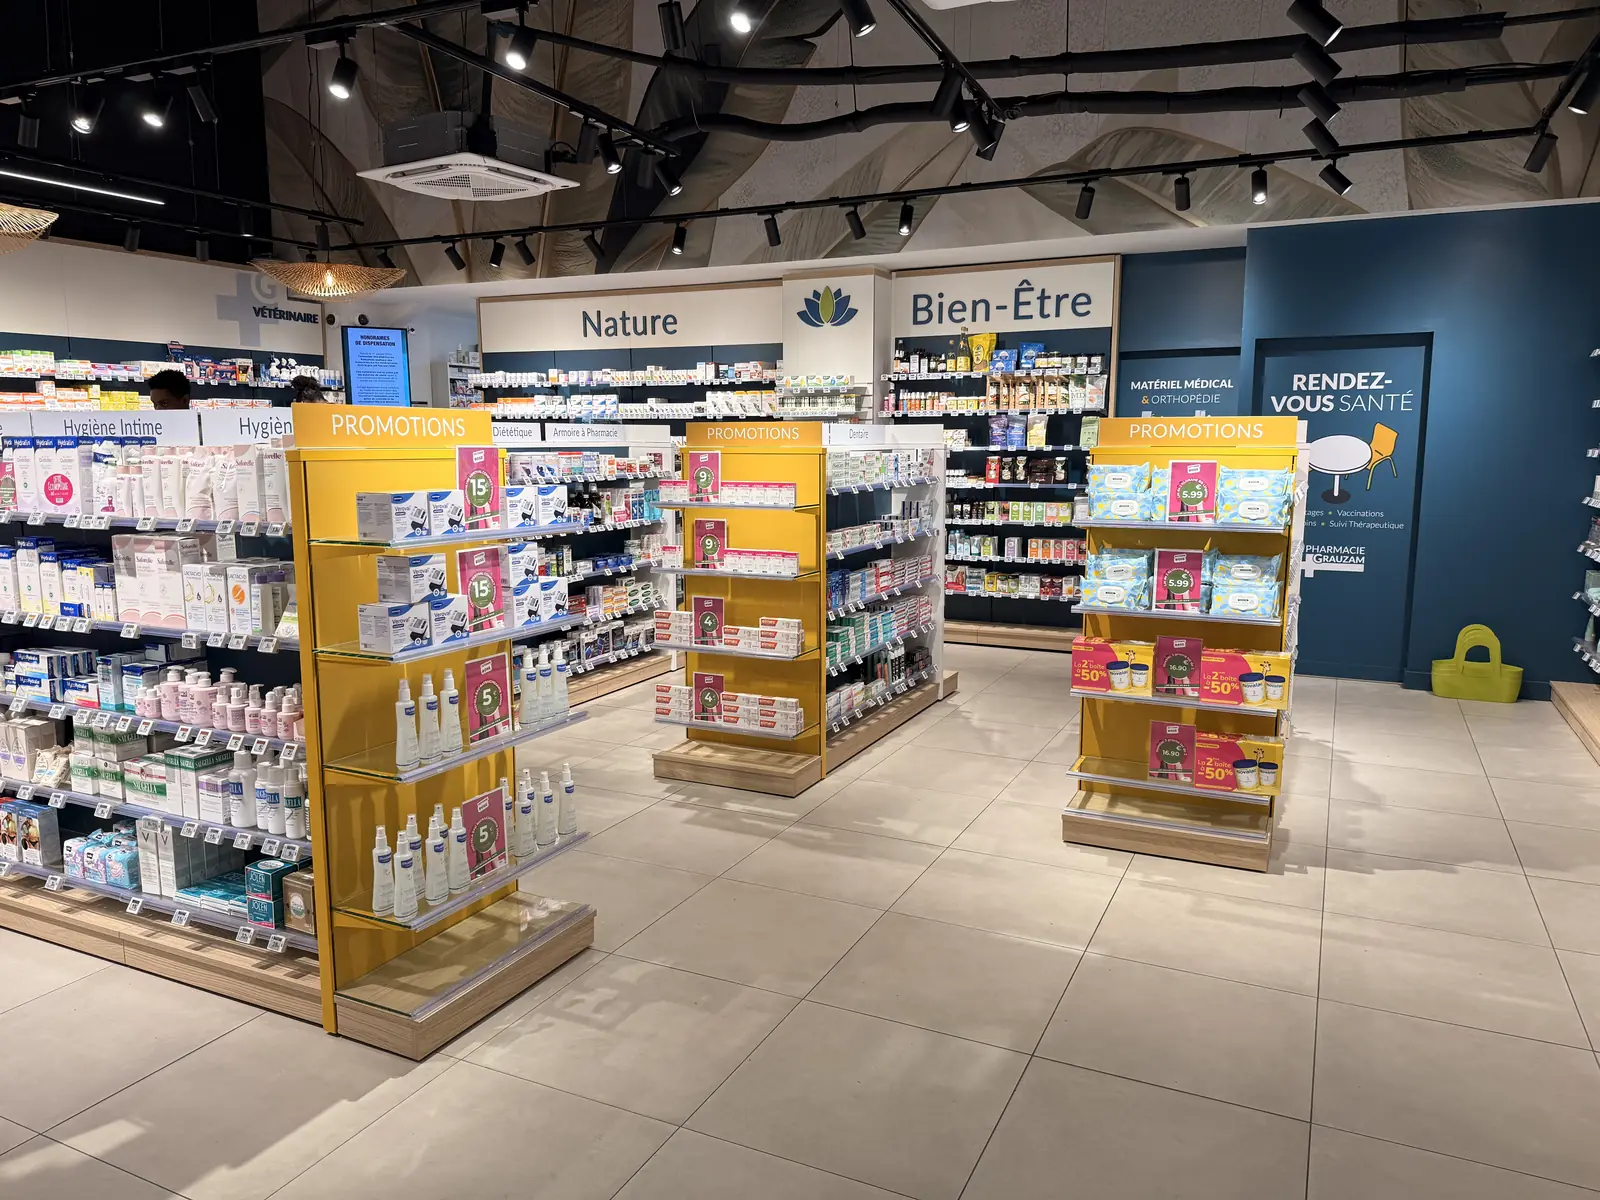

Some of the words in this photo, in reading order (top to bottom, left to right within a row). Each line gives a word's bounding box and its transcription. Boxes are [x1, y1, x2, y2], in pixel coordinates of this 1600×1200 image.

[912, 279, 1092, 326] Bien-Être
[253, 306, 319, 324] VÉTÉRINAIRE
[582, 310, 678, 338] Nature
[1130, 378, 1182, 390] MATÉRIEL
[1184, 377, 1234, 389] MÉDICAL
[1293, 372, 1392, 391] RENDEZ-
[1141, 395, 1149, 405] &
[1151, 393, 1221, 404] ORTHOPÉDIE
[1271, 395, 1334, 413] VOUS
[1339, 390, 1414, 412] SANTÉ
[64, 418, 116, 436] Hygiène
[120, 418, 163, 436] Intime
[239, 417, 292, 439] Hygièn
[331, 414, 466, 438] PROMOTIONS
[493, 426, 533, 438] Diététique
[553, 428, 579, 437] Armoire
[581, 427, 585, 437] à
[587, 428, 618, 437] Pharmacie
[1129, 423, 1264, 439] PROMOTIONS
[707, 426, 800, 440] PROMOTIONS
[848, 428, 869, 439] Dentaire
[1182, 491, 1203, 499] 5.99
[1336, 509, 1384, 518] Vaccinations
[1329, 520, 1347, 528] Suivi
[1349, 520, 1405, 530] Thérapeutique
[1305, 545, 1366, 555] PHARMACIE
[1313, 553, 1365, 565] GRAUZAM
[1168, 579, 1189, 588] 5.99
[1169, 664, 1188, 672] 16.90
[1074, 669, 1107, 682] -50%
[1203, 681, 1240, 695] -50%
[1197, 767, 1234, 780] -50%
[133, 781, 158, 794] SAUGELLA
[250, 870, 266, 884] JOLEN
[252, 900, 268, 913] JOLEN
